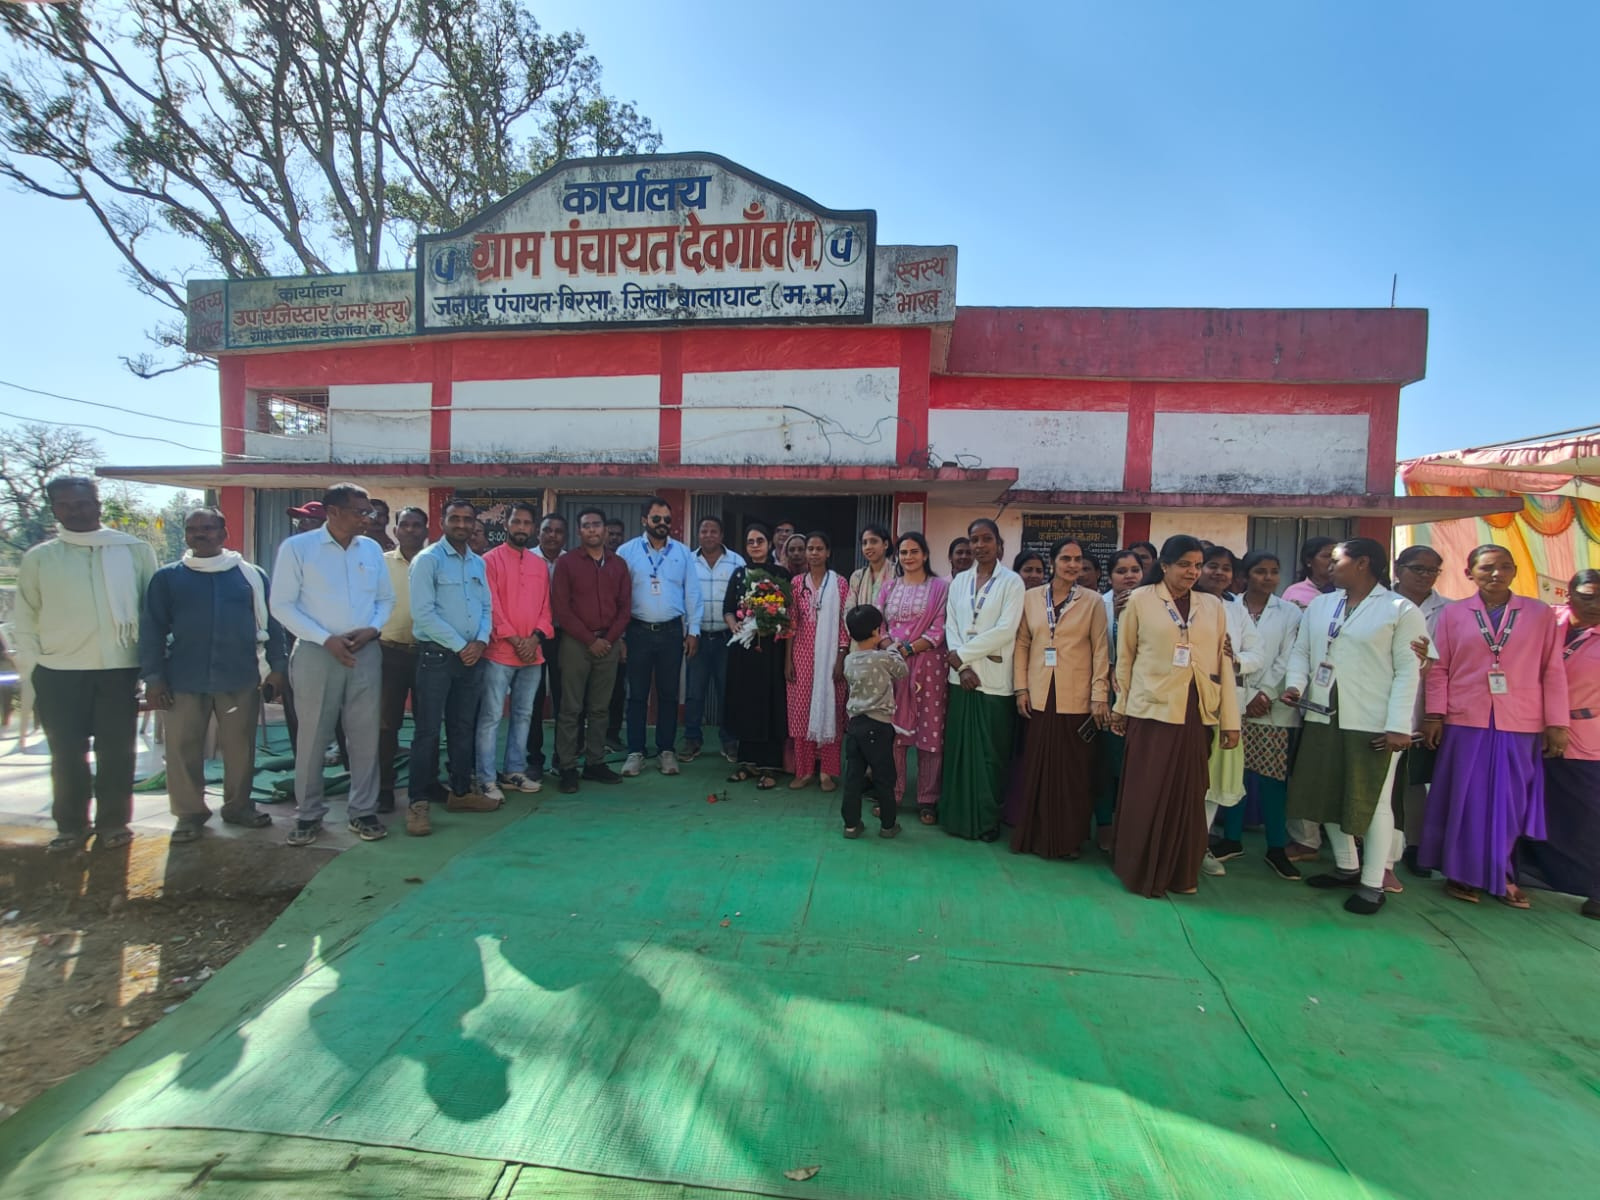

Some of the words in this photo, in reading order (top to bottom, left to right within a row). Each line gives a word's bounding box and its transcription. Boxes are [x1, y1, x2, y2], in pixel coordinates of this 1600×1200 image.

[563, 168, 712, 215] कार्यालय
[472, 231, 546, 283] ग्राम
[551, 218, 680, 278] पंचायत
[896, 257, 948, 287] स्वस्थ
[278, 281, 346, 301] कार्यालय
[432, 294, 490, 317] जनपद
[621, 282, 667, 311] जिला
[677, 285, 766, 310] बालाघाट
[896, 289, 942, 314] भारत
